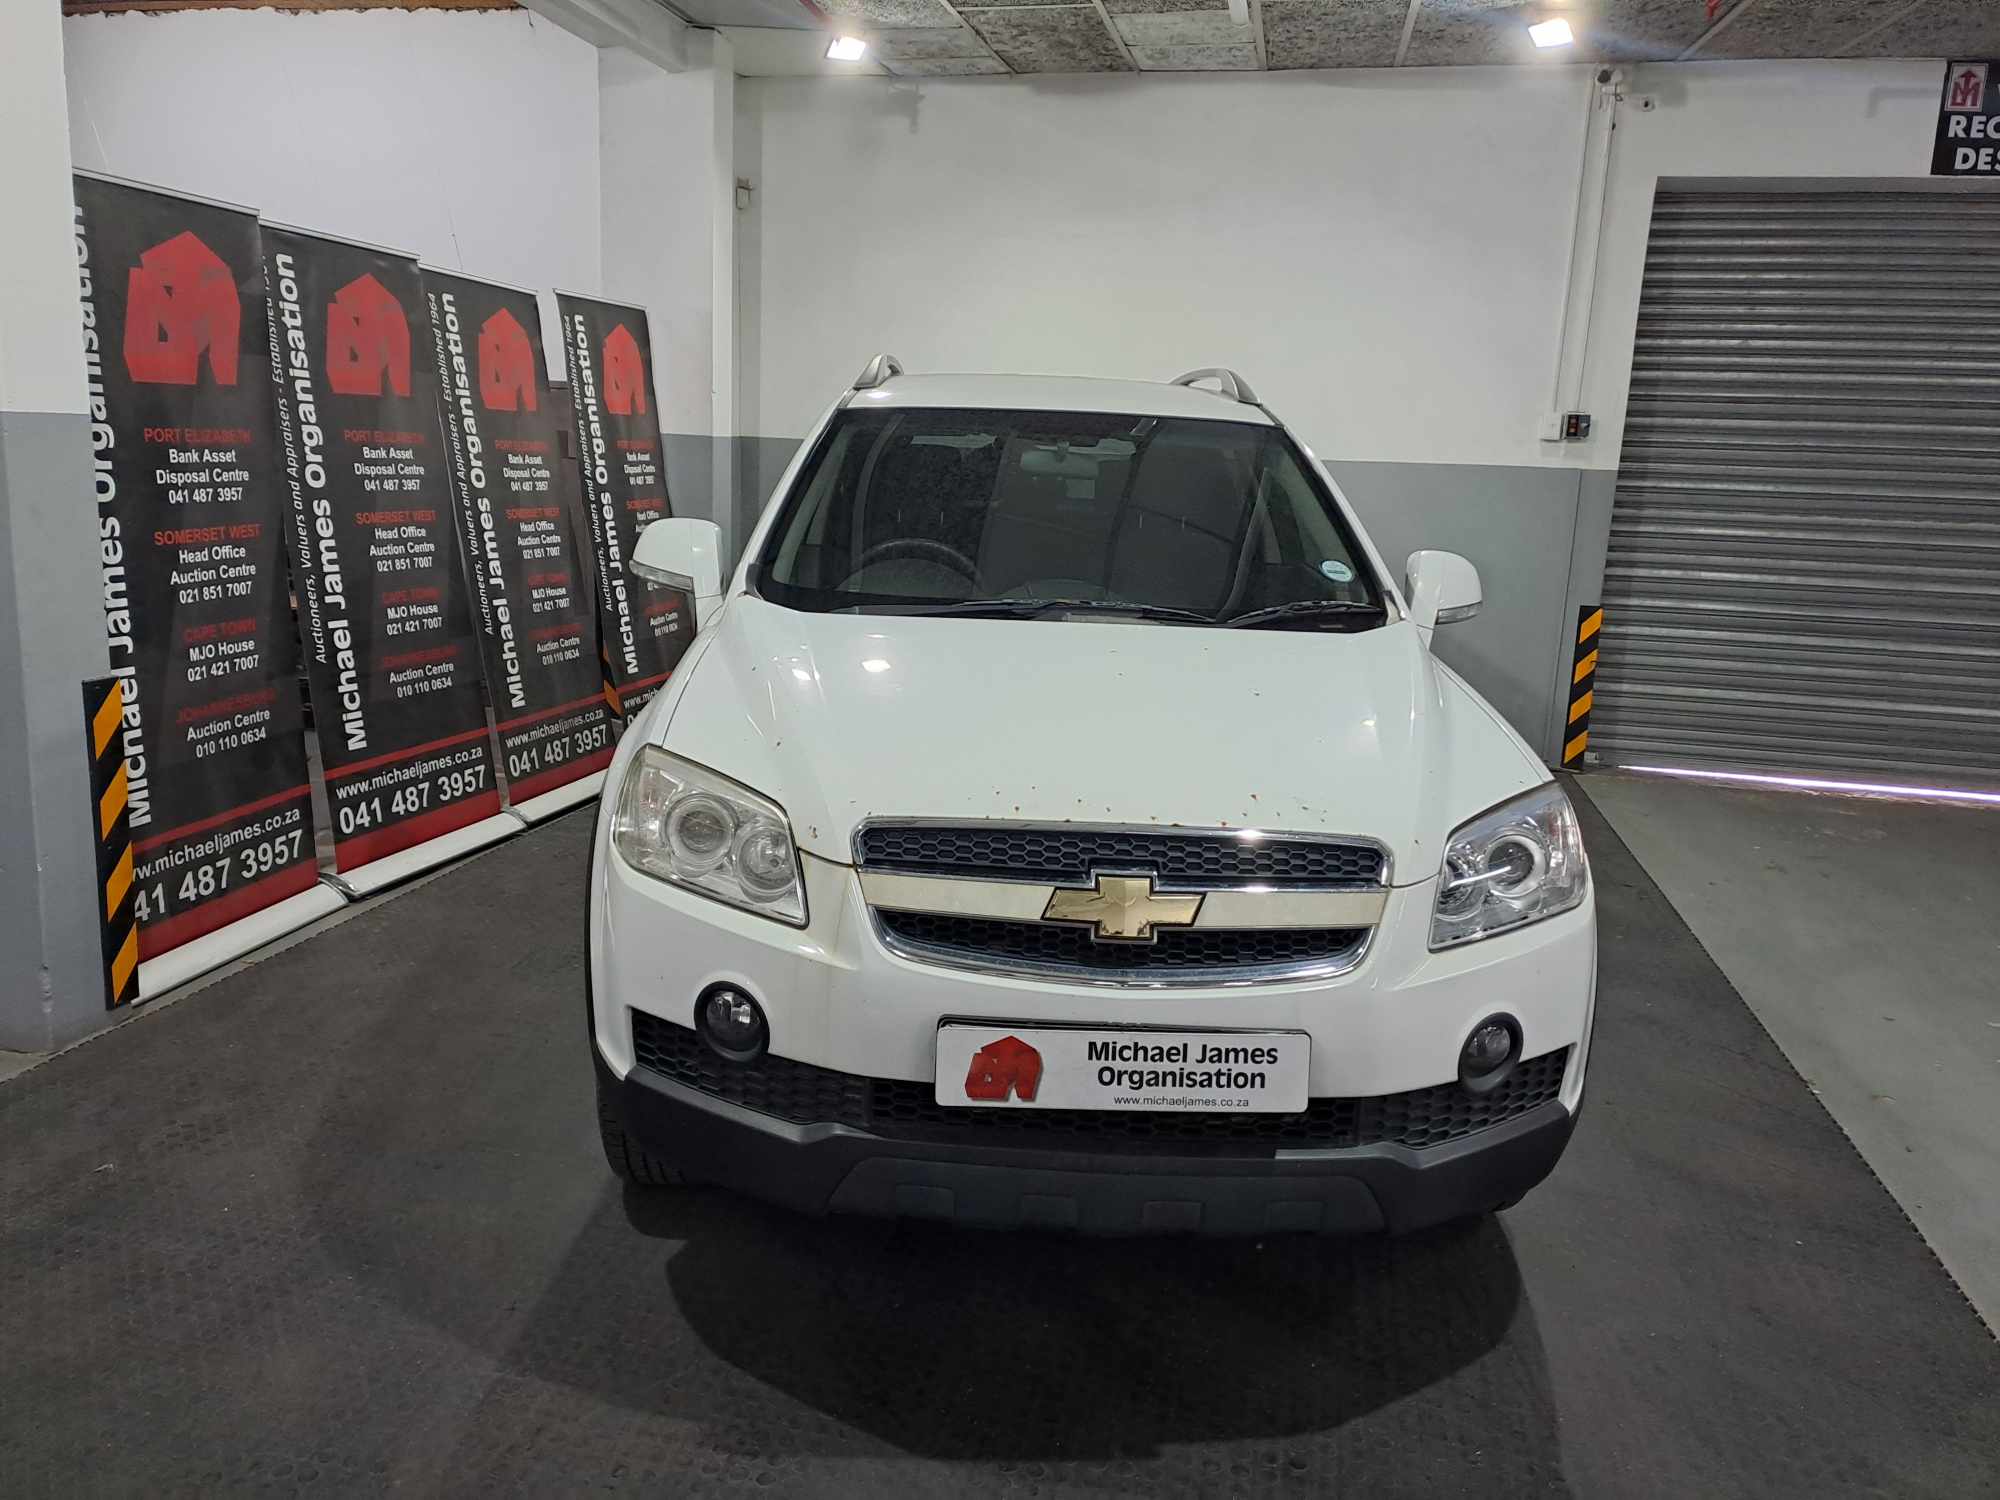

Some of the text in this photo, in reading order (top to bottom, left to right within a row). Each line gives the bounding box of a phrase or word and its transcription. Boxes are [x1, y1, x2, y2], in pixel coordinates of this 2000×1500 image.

[144, 427, 182, 443] PORT
[278, 398, 300, 478] Appraisers
[169, 448, 236, 463] Bank Asset
[363, 446, 414, 459] Bank Asset
[427, 292, 495, 635] Auctioneers, Valuers and Appraisers Established 1964
[156, 467, 249, 487] Disposal Centre
[354, 463, 425, 477] Disposal Centre
[168, 487, 243, 504] 041 487 3957
[288, 480, 303, 510] and
[364, 479, 420, 491] 041 487 3957
[574, 314, 639, 675] Michael James Organisation
[585, 479, 595, 501] and
[275, 253, 367, 751] Michael James Organisation
[441, 292, 526, 709] Michael James Organisation
[154, 523, 262, 545] SOMERSET WEST
[375, 526, 426, 539] Head Office
[590, 502, 602, 543] Valuers
[295, 514, 312, 568] Valuers
[369, 541, 435, 556] Auction Centre
[179, 545, 246, 564] Head Office
[377, 556, 432, 572] 021 851 7007
[100, 516, 135, 655] James
[170, 564, 256, 585] Auction Centre
[179, 581, 252, 605] 021 851 7007
[305, 574, 327, 663] Auctioneers,
[387, 604, 438, 620] MJO House
[386, 617, 442, 636] 021 421 7007
[189, 640, 255, 662] MJO House
[187, 655, 259, 682] 021 421 7007
[389, 662, 454, 684] Auction Centre
[396, 676, 452, 698] 010 110 0634
[187, 709, 270, 741] Auction Centre
[505, 709, 604, 748] www.michaeljames.co.za
[111, 666, 152, 828] Michael
[196, 726, 266, 758] 010 110 0634
[509, 724, 607, 777] 041 487 3957
[336, 746, 483, 799] www.michaeljames.co.za
[339, 764, 486, 834] 041 487 3957
[178, 857, 231, 901] 487
[240, 829, 302, 878] 3957
[1087, 1041, 1278, 1065] Michael James
[1097, 1066, 1266, 1091] Organisation
[1113, 1095, 1249, 1108] www.michaeljames.co.za
